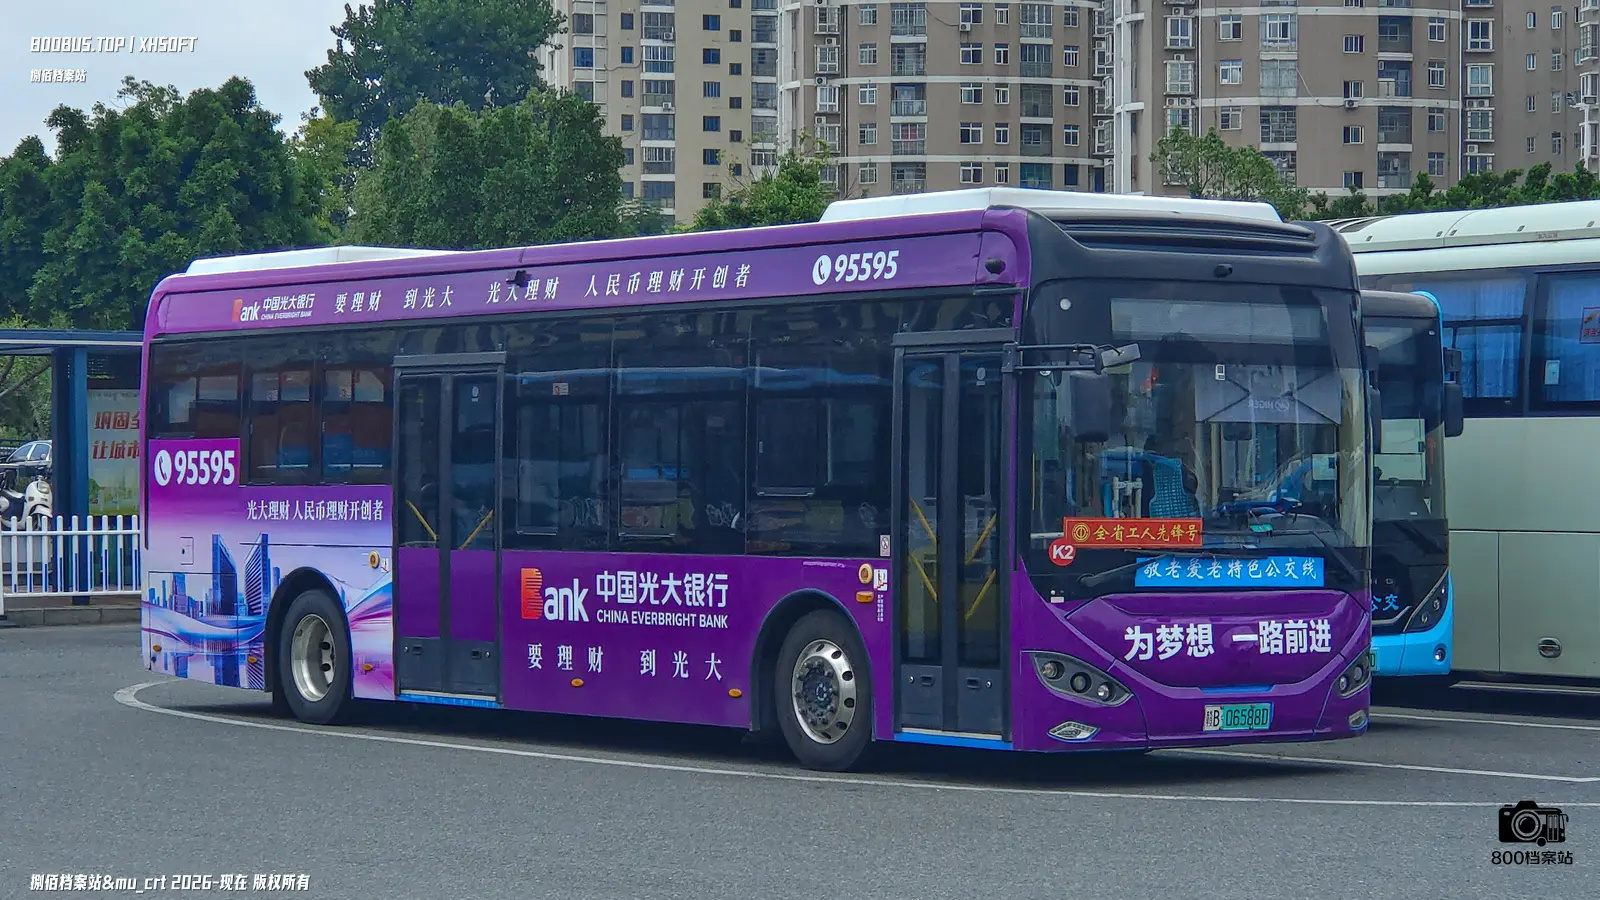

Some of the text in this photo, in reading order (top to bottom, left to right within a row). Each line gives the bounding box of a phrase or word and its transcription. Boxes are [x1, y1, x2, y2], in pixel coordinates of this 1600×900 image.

[833, 251, 899, 282] 95595
[262, 293, 316, 311] 中国光大银行
[333, 290, 382, 314] 要理财
[403, 288, 453, 309] 到光大
[584, 263, 751, 298] 人民币理财开创者
[174, 450, 235, 485] 95595
[246, 500, 384, 521] 光大理财 人民币理财开创者
[1094, 524, 1199, 542] 全省工人先锋号
[1052, 545, 1074, 560] K2
[1143, 557, 1317, 580] 敬老爱老特色公交线
[521, 567, 589, 622] Bank
[596, 570, 729, 608] 中国光大银行
[596, 609, 728, 629] CHINA EVERBRIGHT BANK
[1124, 619, 1332, 662] 为梦想 一路前进
[527, 643, 723, 681] 要理财 到光大
